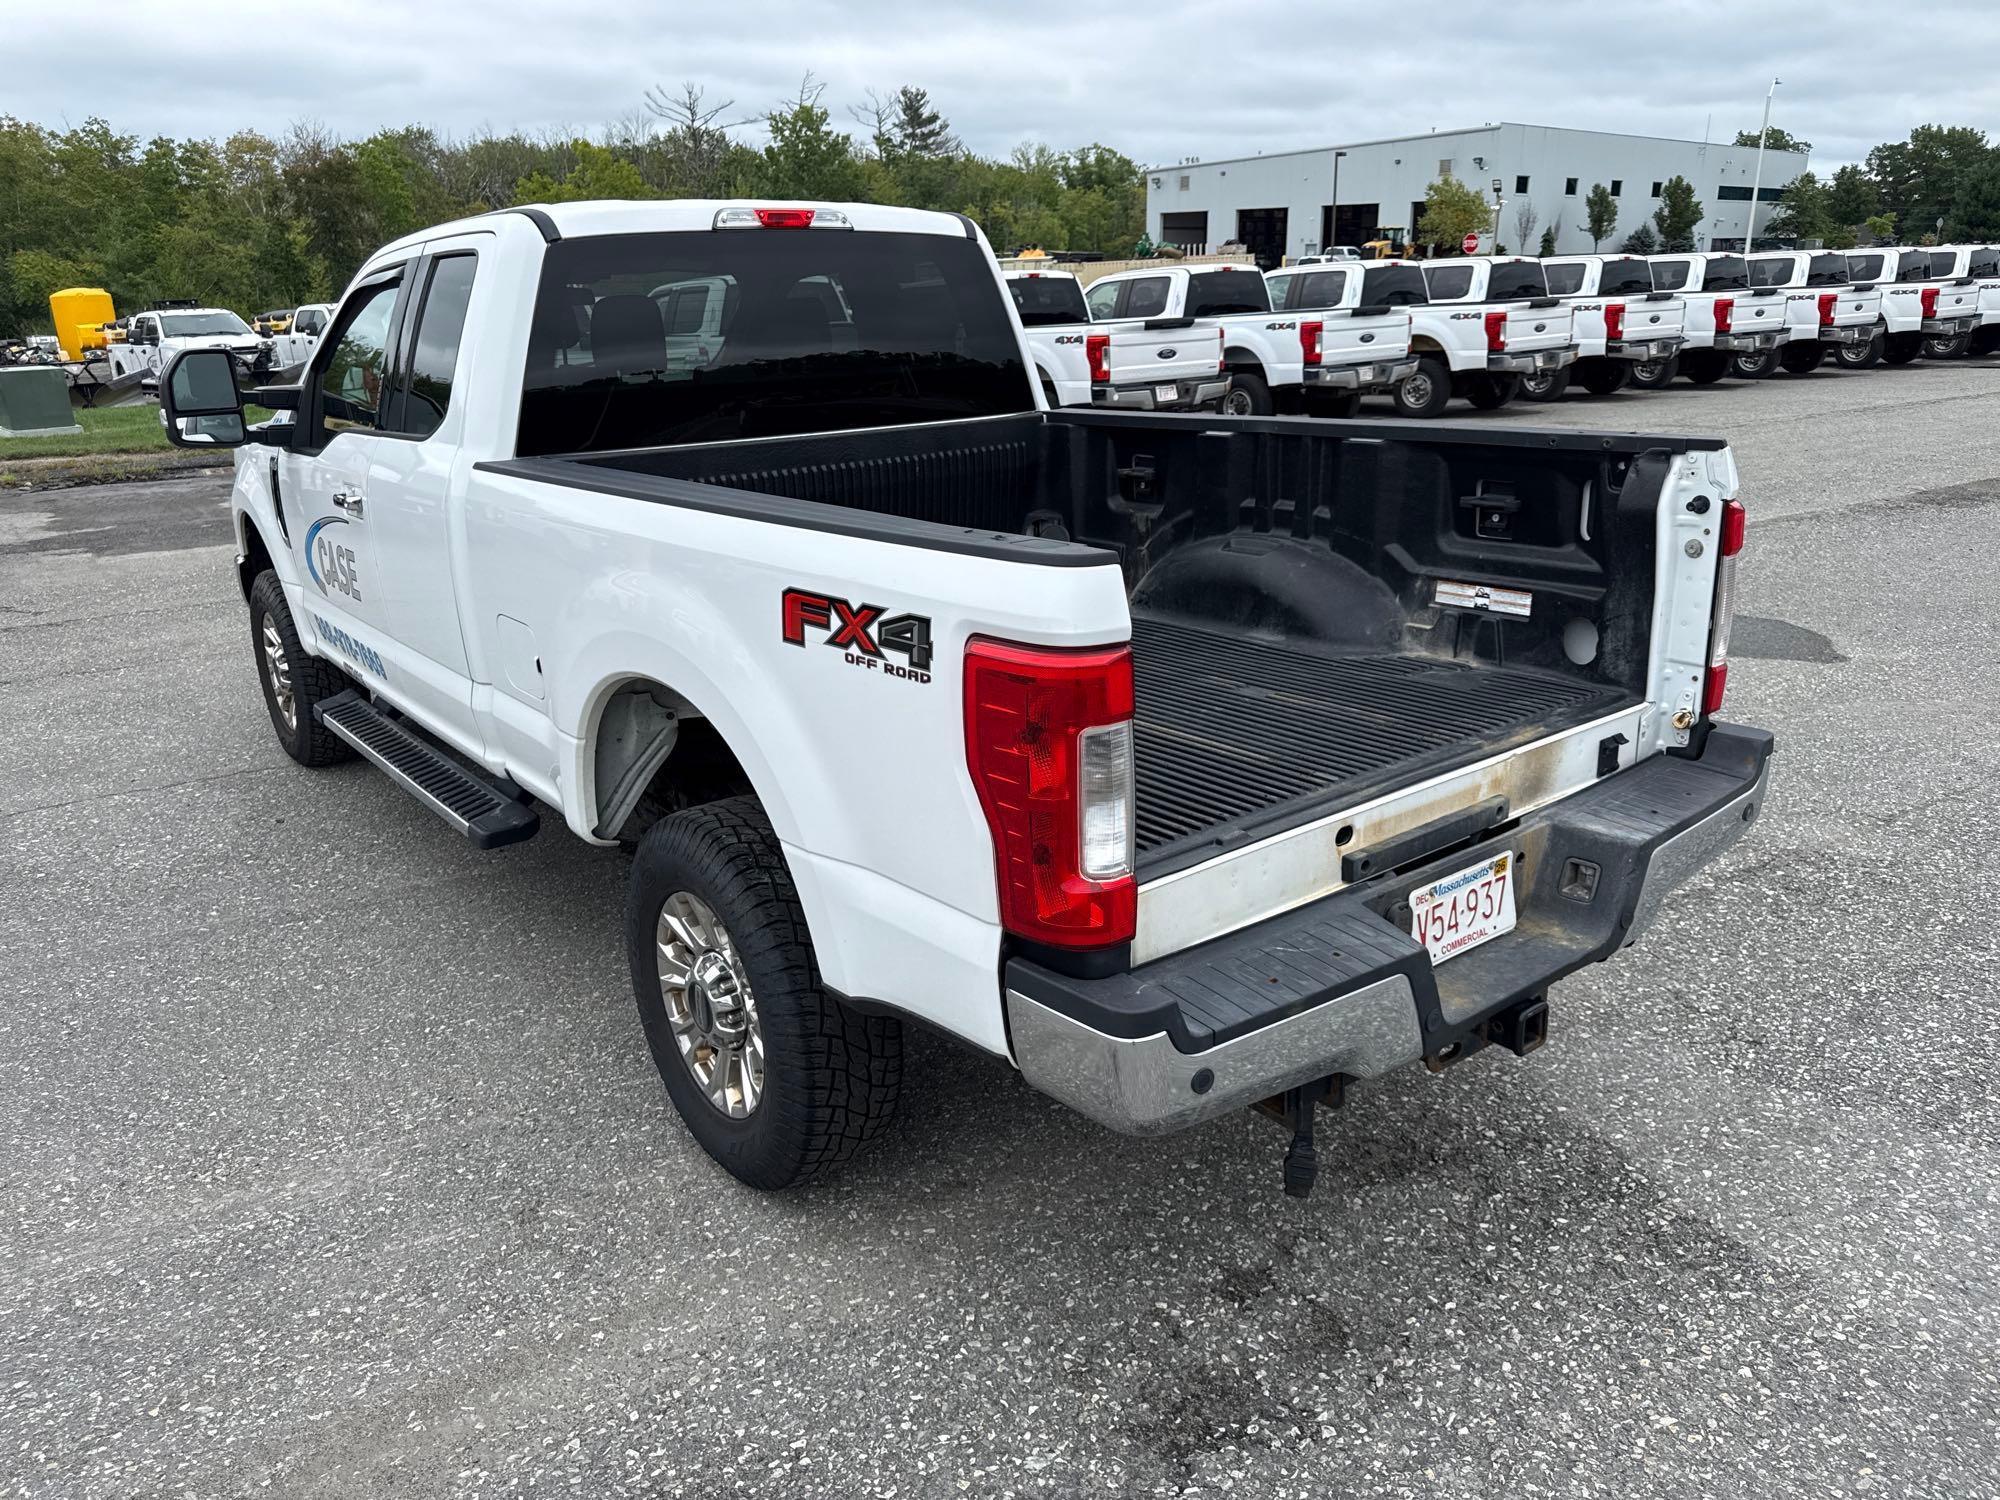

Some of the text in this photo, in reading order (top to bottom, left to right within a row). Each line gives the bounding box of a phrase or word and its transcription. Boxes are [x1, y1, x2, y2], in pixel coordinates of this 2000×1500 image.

[1463, 239, 1478, 248] STOP
[318, 536, 362, 602] CASE
[782, 586, 933, 673] FX4
[844, 652, 932, 684] OFF ROAD
[1415, 892, 1429, 906] DEC
[1433, 866, 1490, 897] Massachusetts
[1440, 927, 1489, 955] COMMERCIAL
